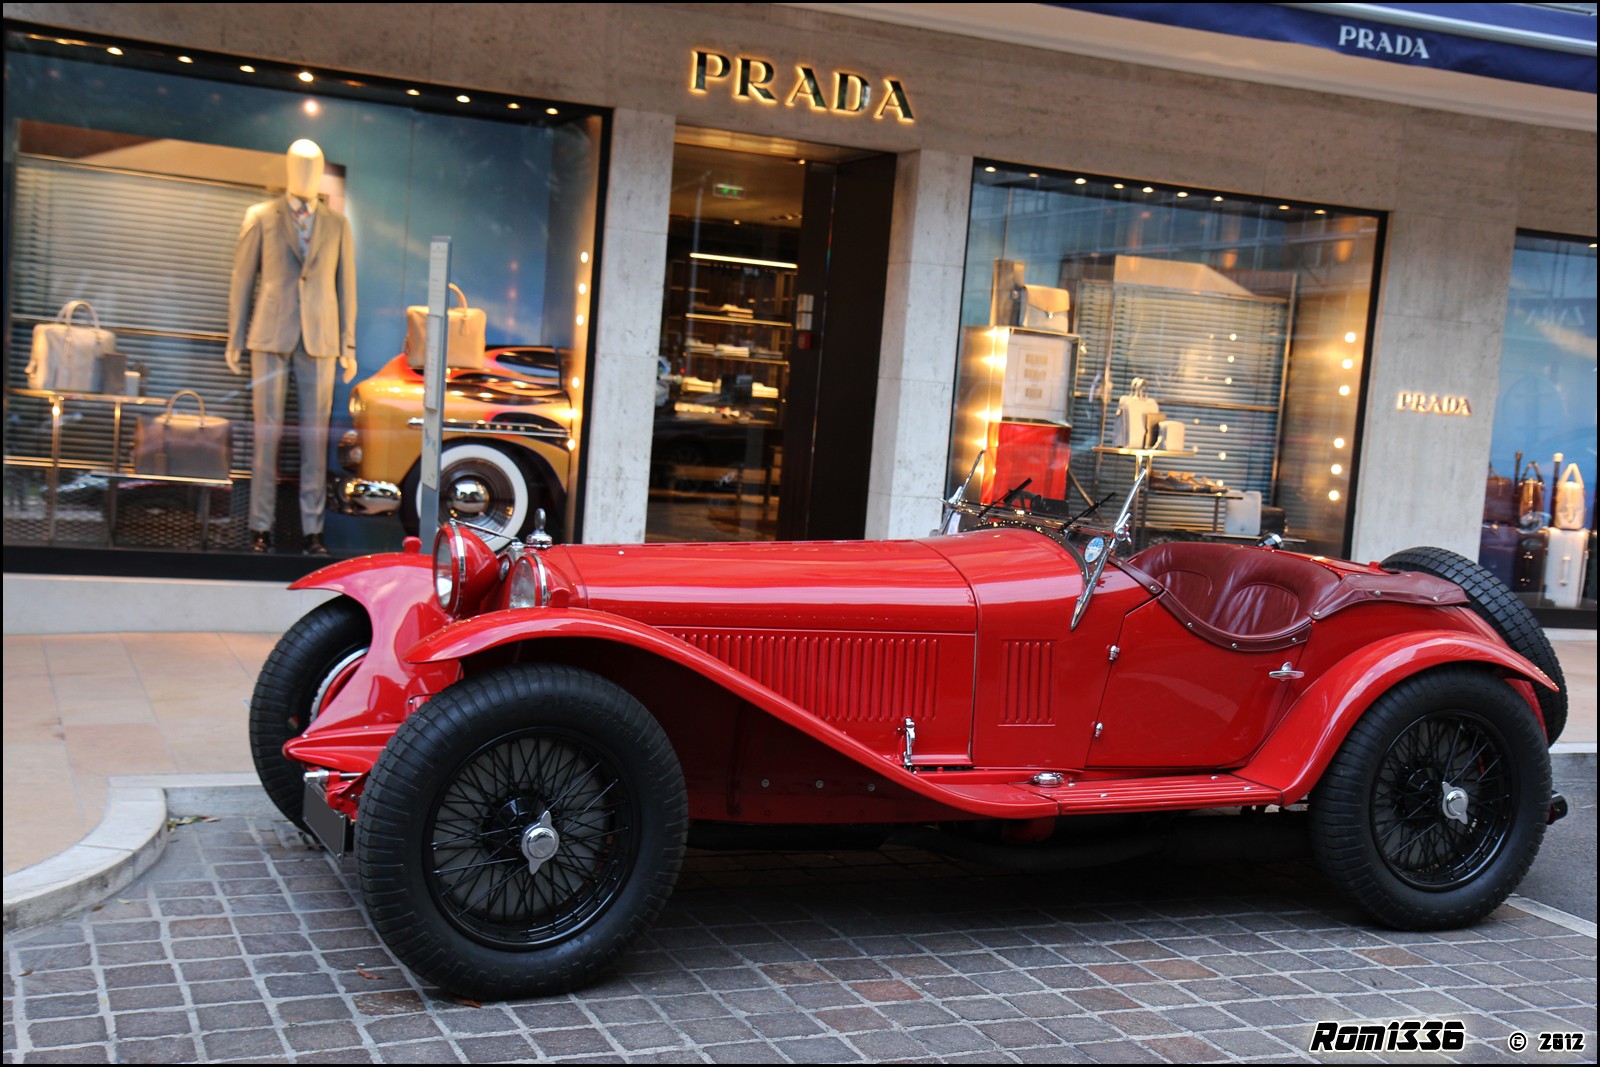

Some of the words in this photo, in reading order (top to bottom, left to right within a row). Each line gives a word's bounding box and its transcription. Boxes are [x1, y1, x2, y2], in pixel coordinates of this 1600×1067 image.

[1338, 25, 1430, 59] PRADA
[689, 50, 916, 123] PRADA
[1396, 391, 1472, 417] PRADA
